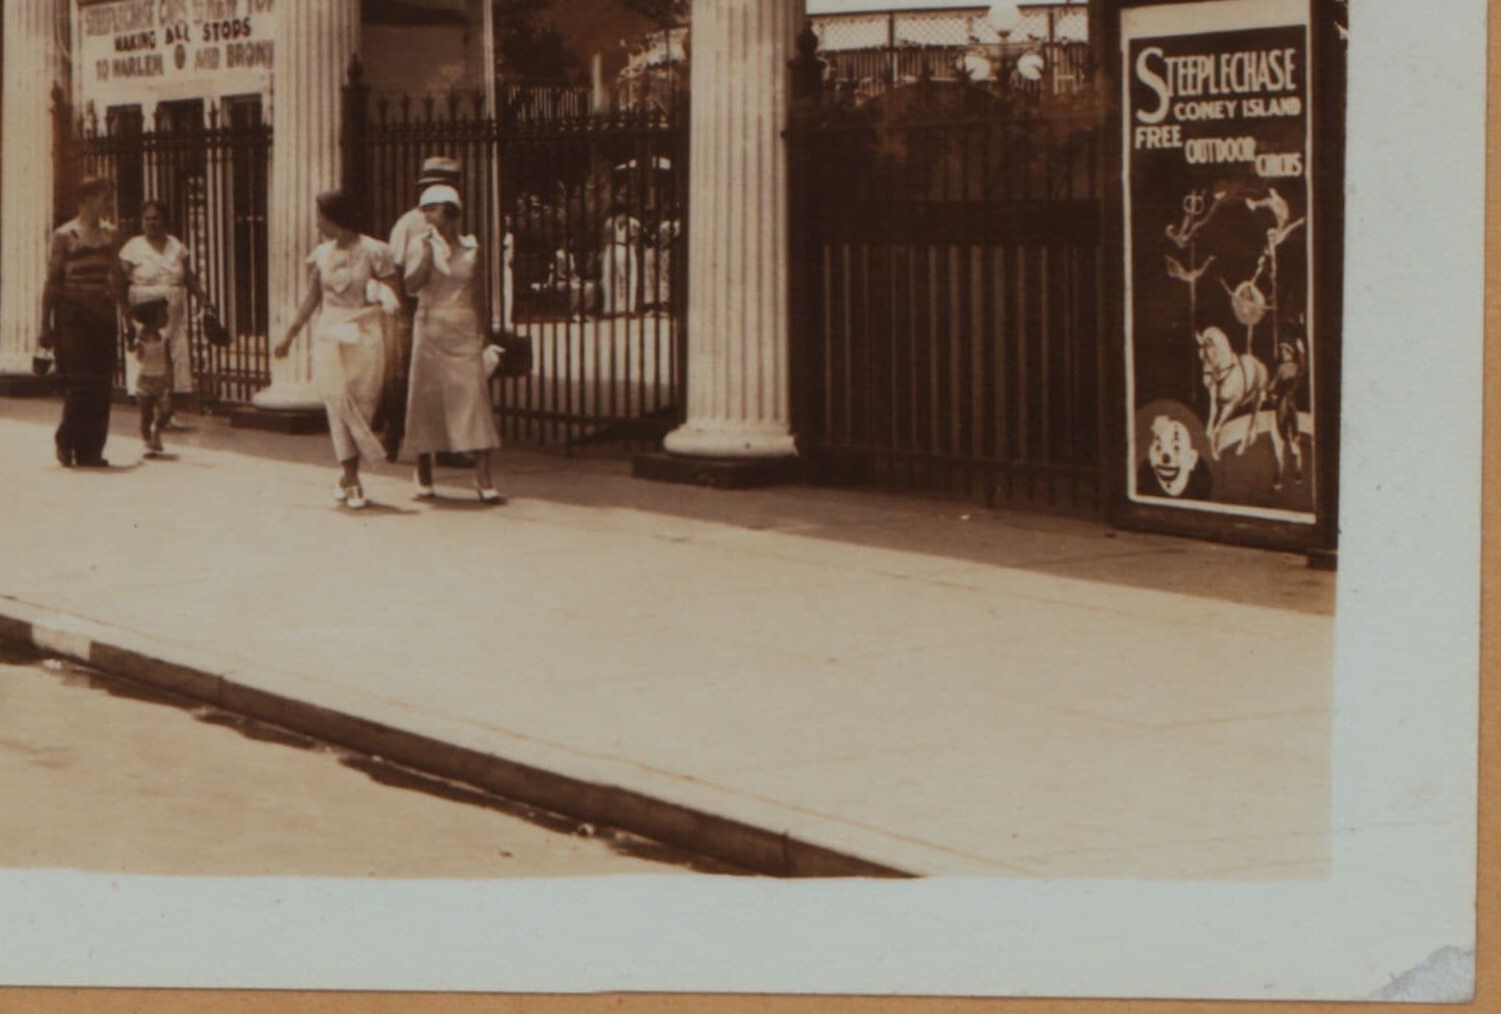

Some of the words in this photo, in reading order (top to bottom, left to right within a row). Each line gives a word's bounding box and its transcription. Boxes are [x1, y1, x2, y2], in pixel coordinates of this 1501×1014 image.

[114, 30, 156, 52] MAKING
[165, 22, 190, 44] ALL
[203, 17, 252, 42] STOPS
[113, 53, 164, 78] HARLEM
[1135, 46, 1297, 124] STEEPLECHASE
[1173, 98, 1238, 121] CONEY
[1242, 95, 1302, 118] ISLAND
[1135, 124, 1182, 150] FREE
[1185, 136, 1256, 164] OUTDOOR
[1255, 151, 1303, 177] CIRCUS
